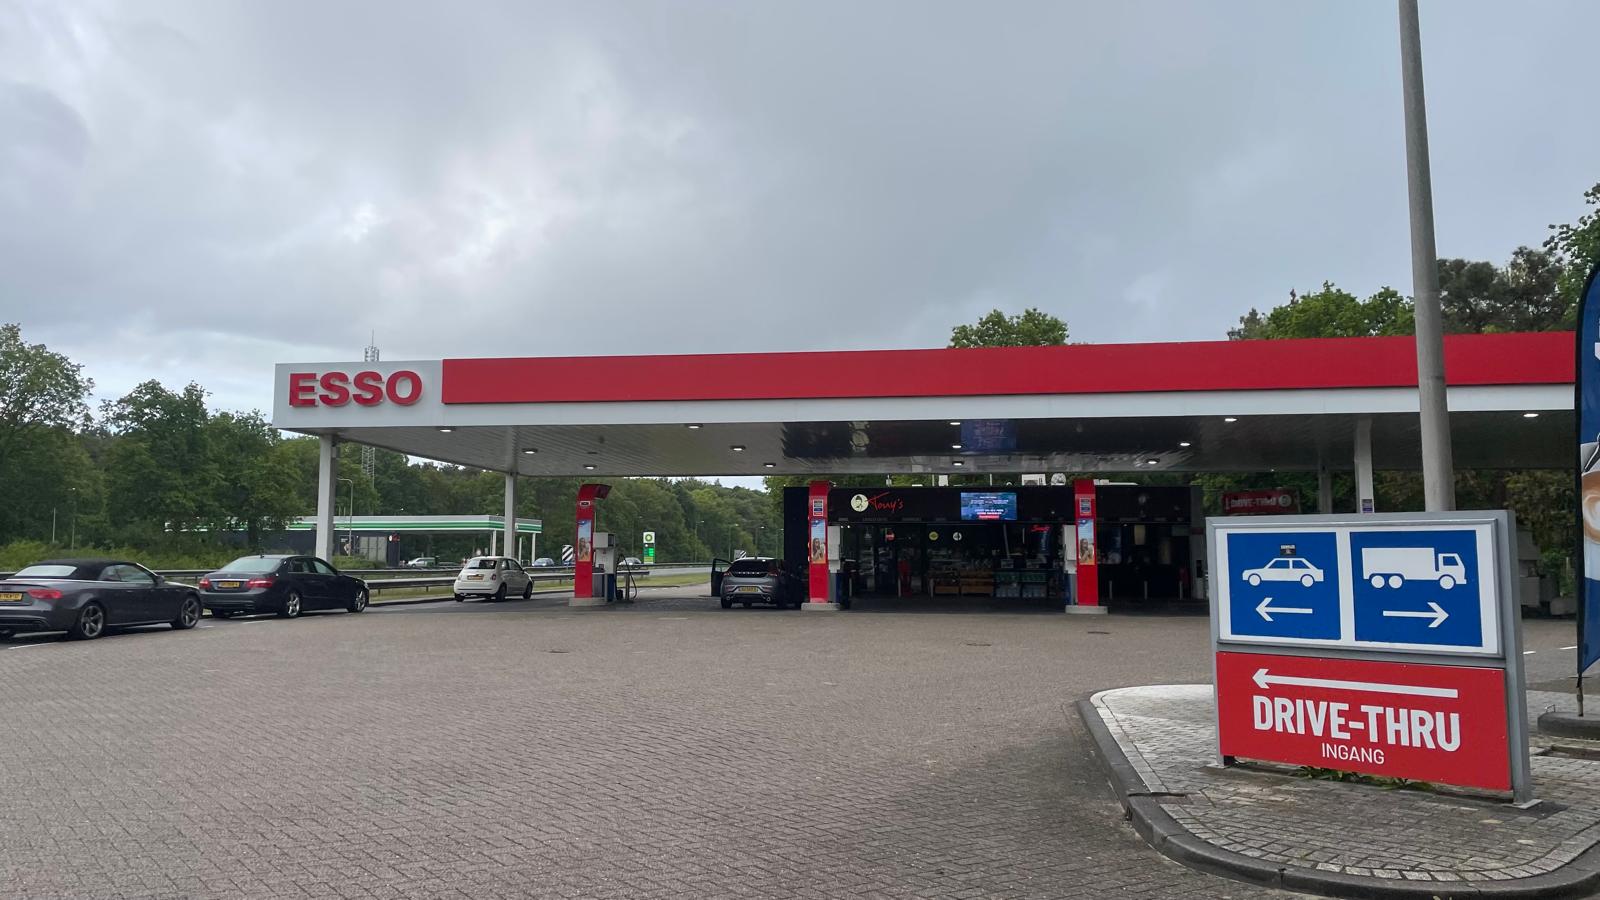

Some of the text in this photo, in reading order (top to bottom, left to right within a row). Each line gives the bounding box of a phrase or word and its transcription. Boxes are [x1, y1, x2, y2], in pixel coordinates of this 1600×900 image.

[289, 370, 423, 407] ESSO
[1253, 695, 1461, 752] DRIVE-THRU
[1322, 742, 1385, 765] INGANG
